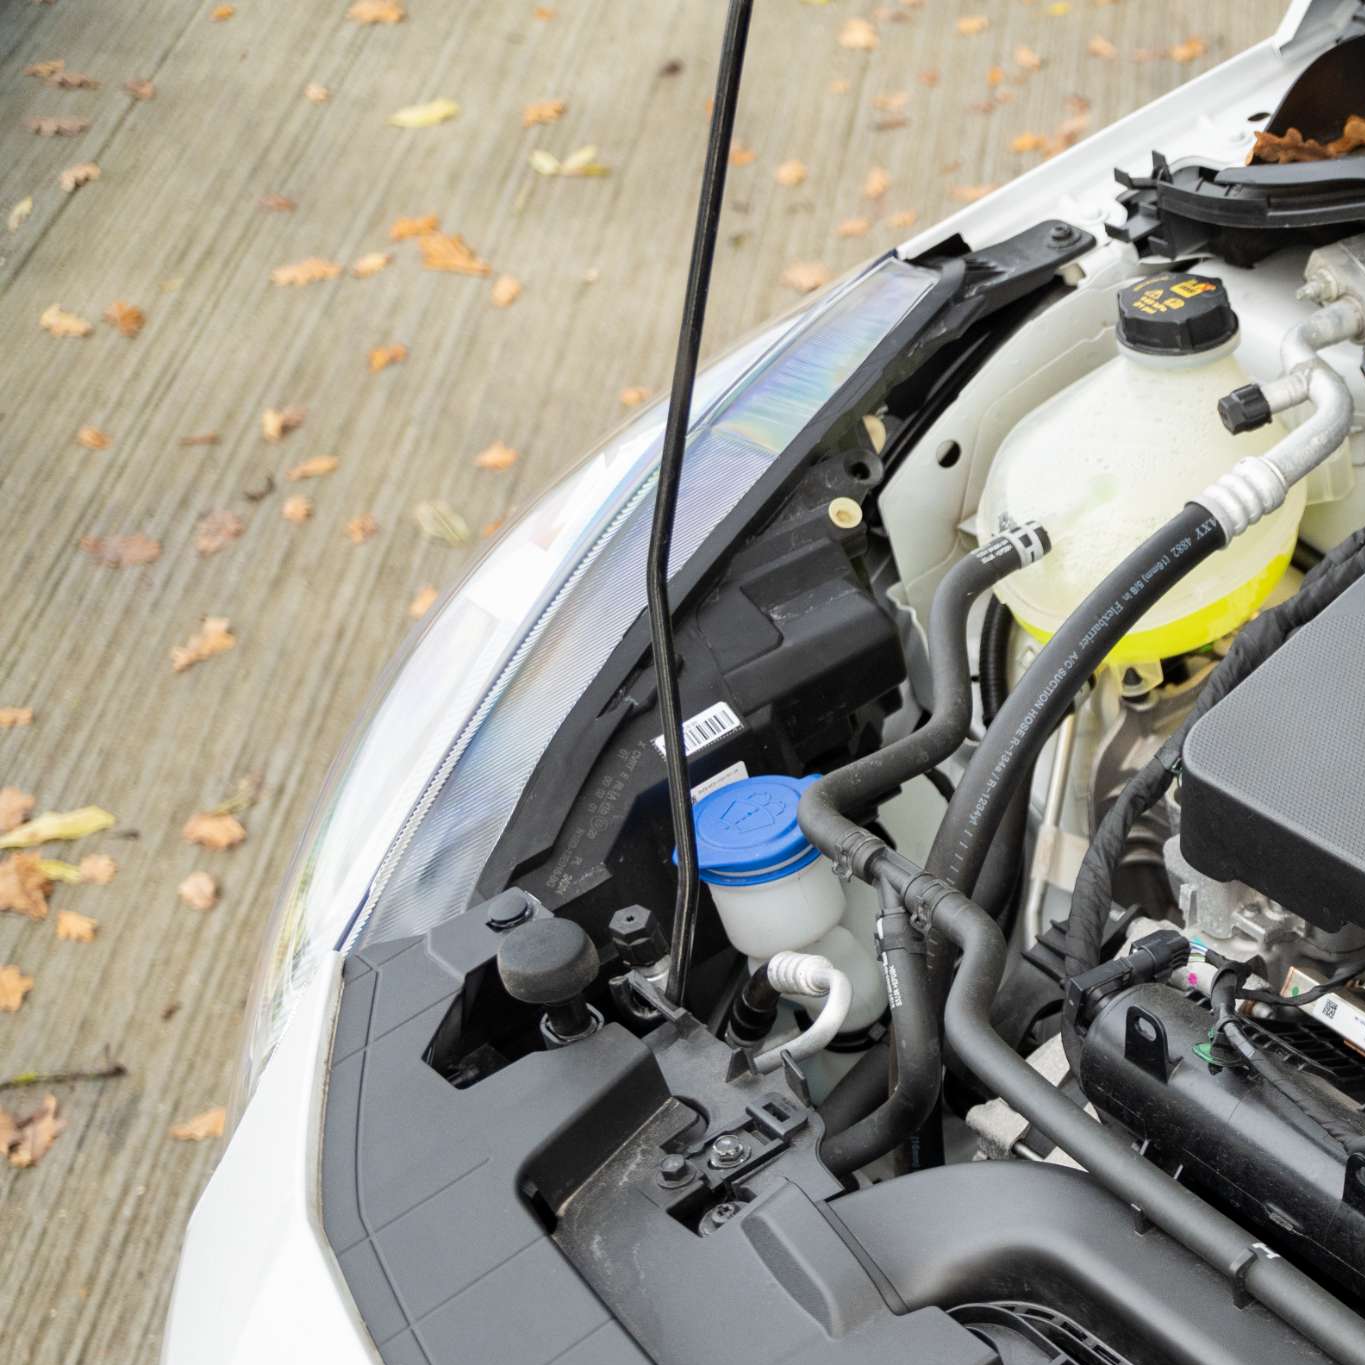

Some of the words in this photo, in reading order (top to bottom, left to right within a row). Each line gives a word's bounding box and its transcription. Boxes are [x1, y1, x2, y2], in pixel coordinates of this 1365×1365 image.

[1170, 537, 1192, 558] 4882
[1036, 667, 1068, 711] SUCTION
[1015, 709, 1038, 738] HOSE
